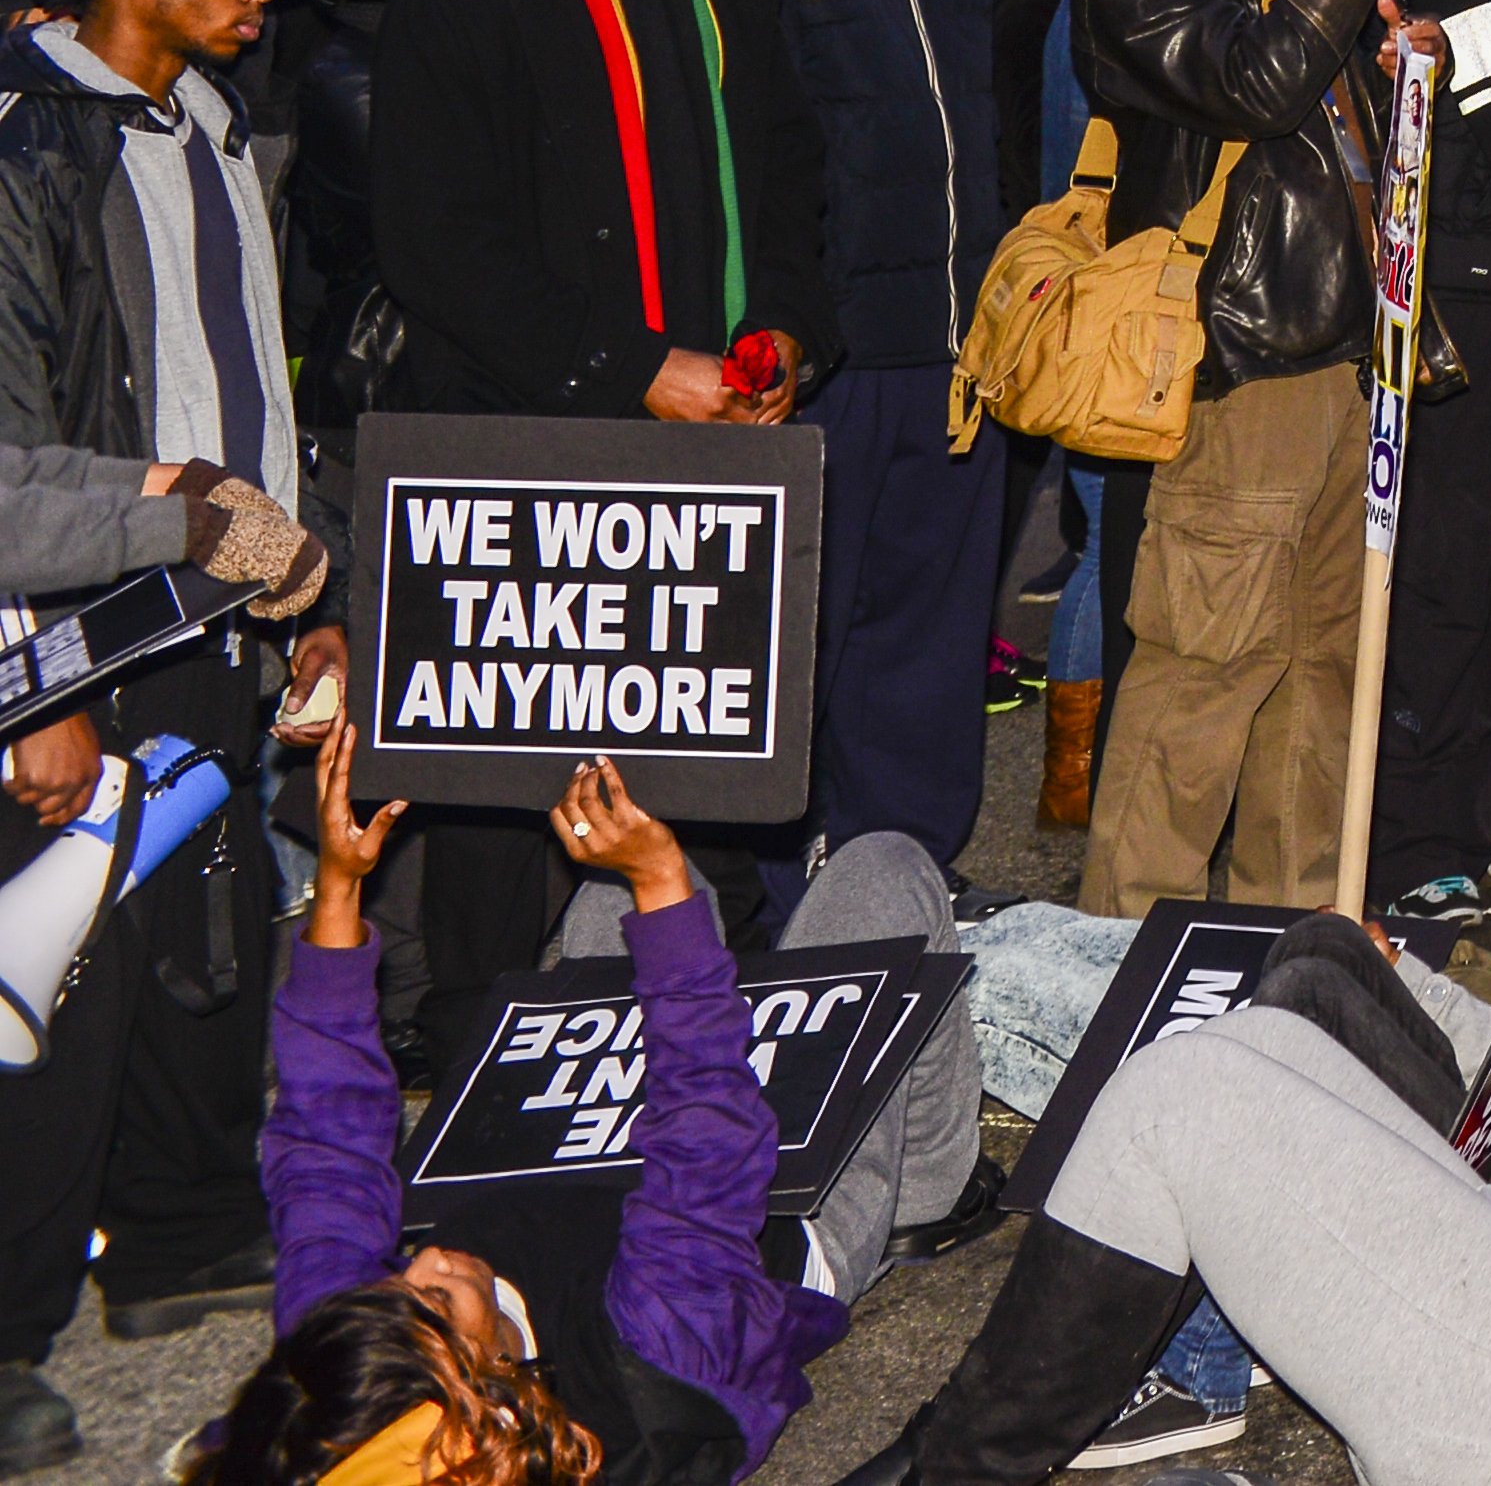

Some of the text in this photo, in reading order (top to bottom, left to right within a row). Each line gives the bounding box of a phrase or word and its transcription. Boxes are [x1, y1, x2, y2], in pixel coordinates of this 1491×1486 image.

[406, 498, 763, 573] WE WON'T
[442, 580, 720, 653] TAKE IT
[395, 660, 752, 736] ANYMORE
